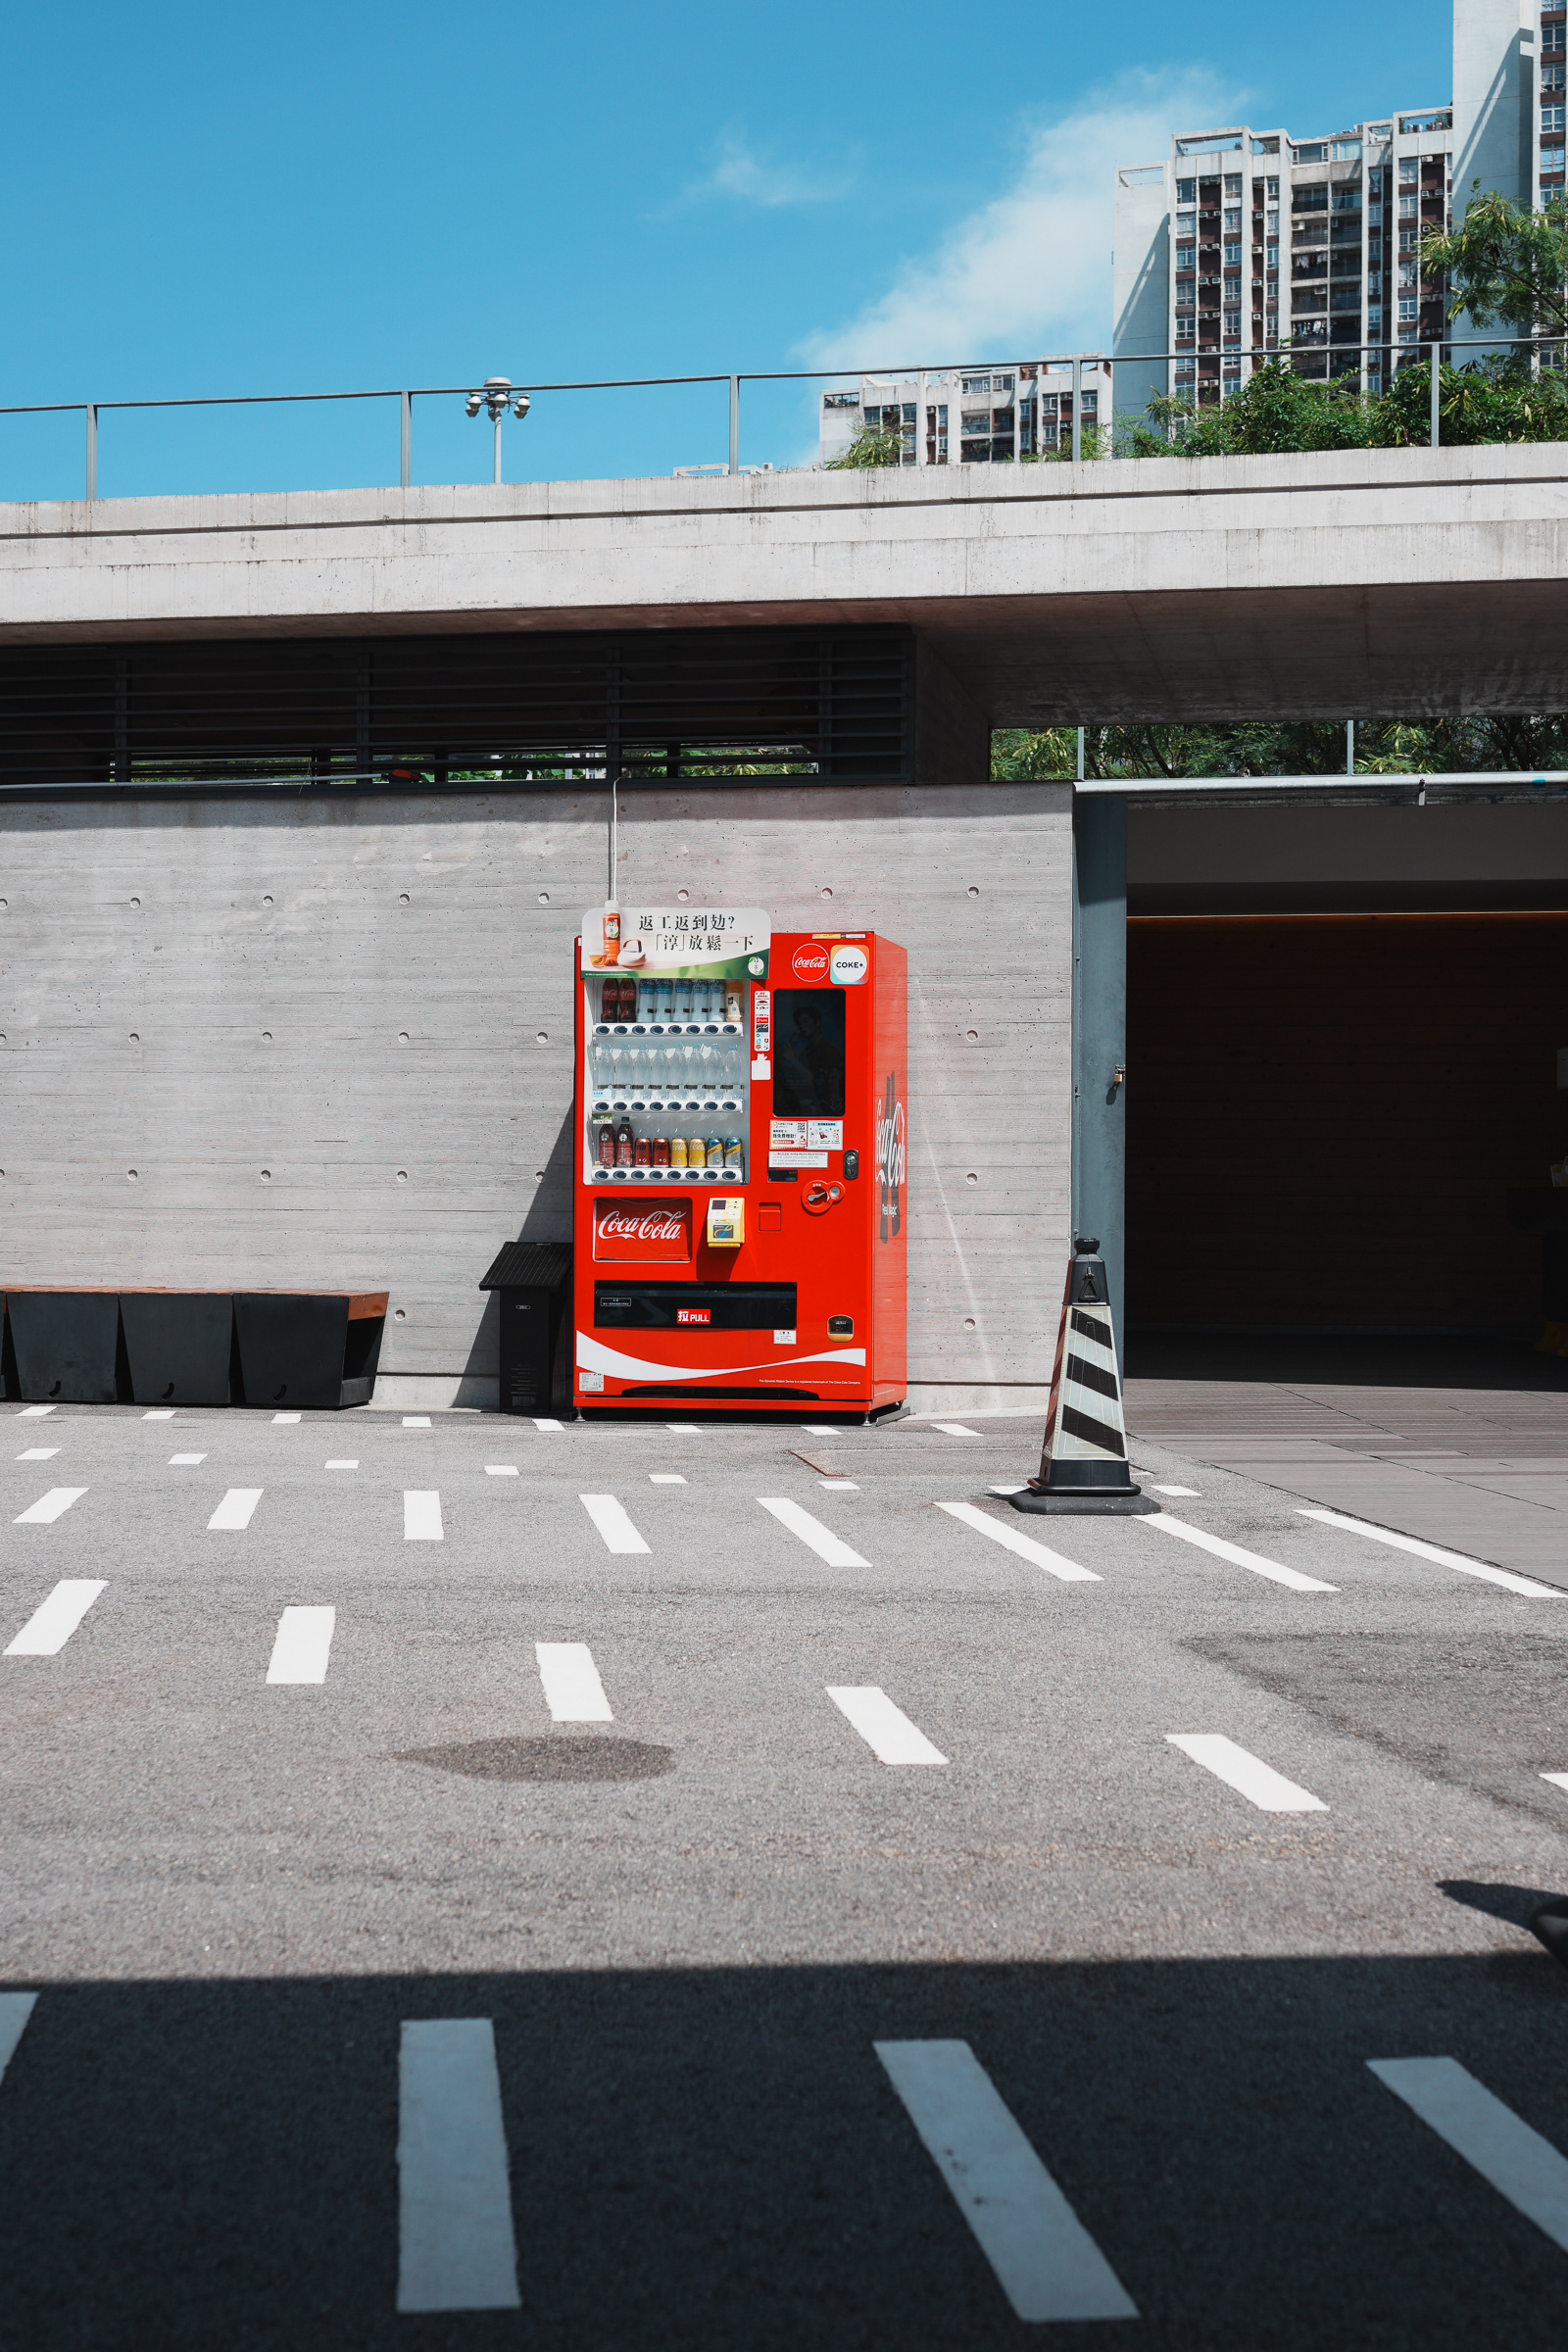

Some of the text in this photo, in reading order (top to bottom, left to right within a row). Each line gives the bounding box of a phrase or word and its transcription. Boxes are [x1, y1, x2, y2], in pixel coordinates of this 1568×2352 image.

[639, 914, 735, 931] 返工返到攰?
[656, 933, 754, 952] 「淳」放鬆一下
[794, 956, 827, 969] Coca-Cola
[598, 1210, 686, 1240] Coca-Cola
[678, 1310, 710, 1322] 拉 PULL
